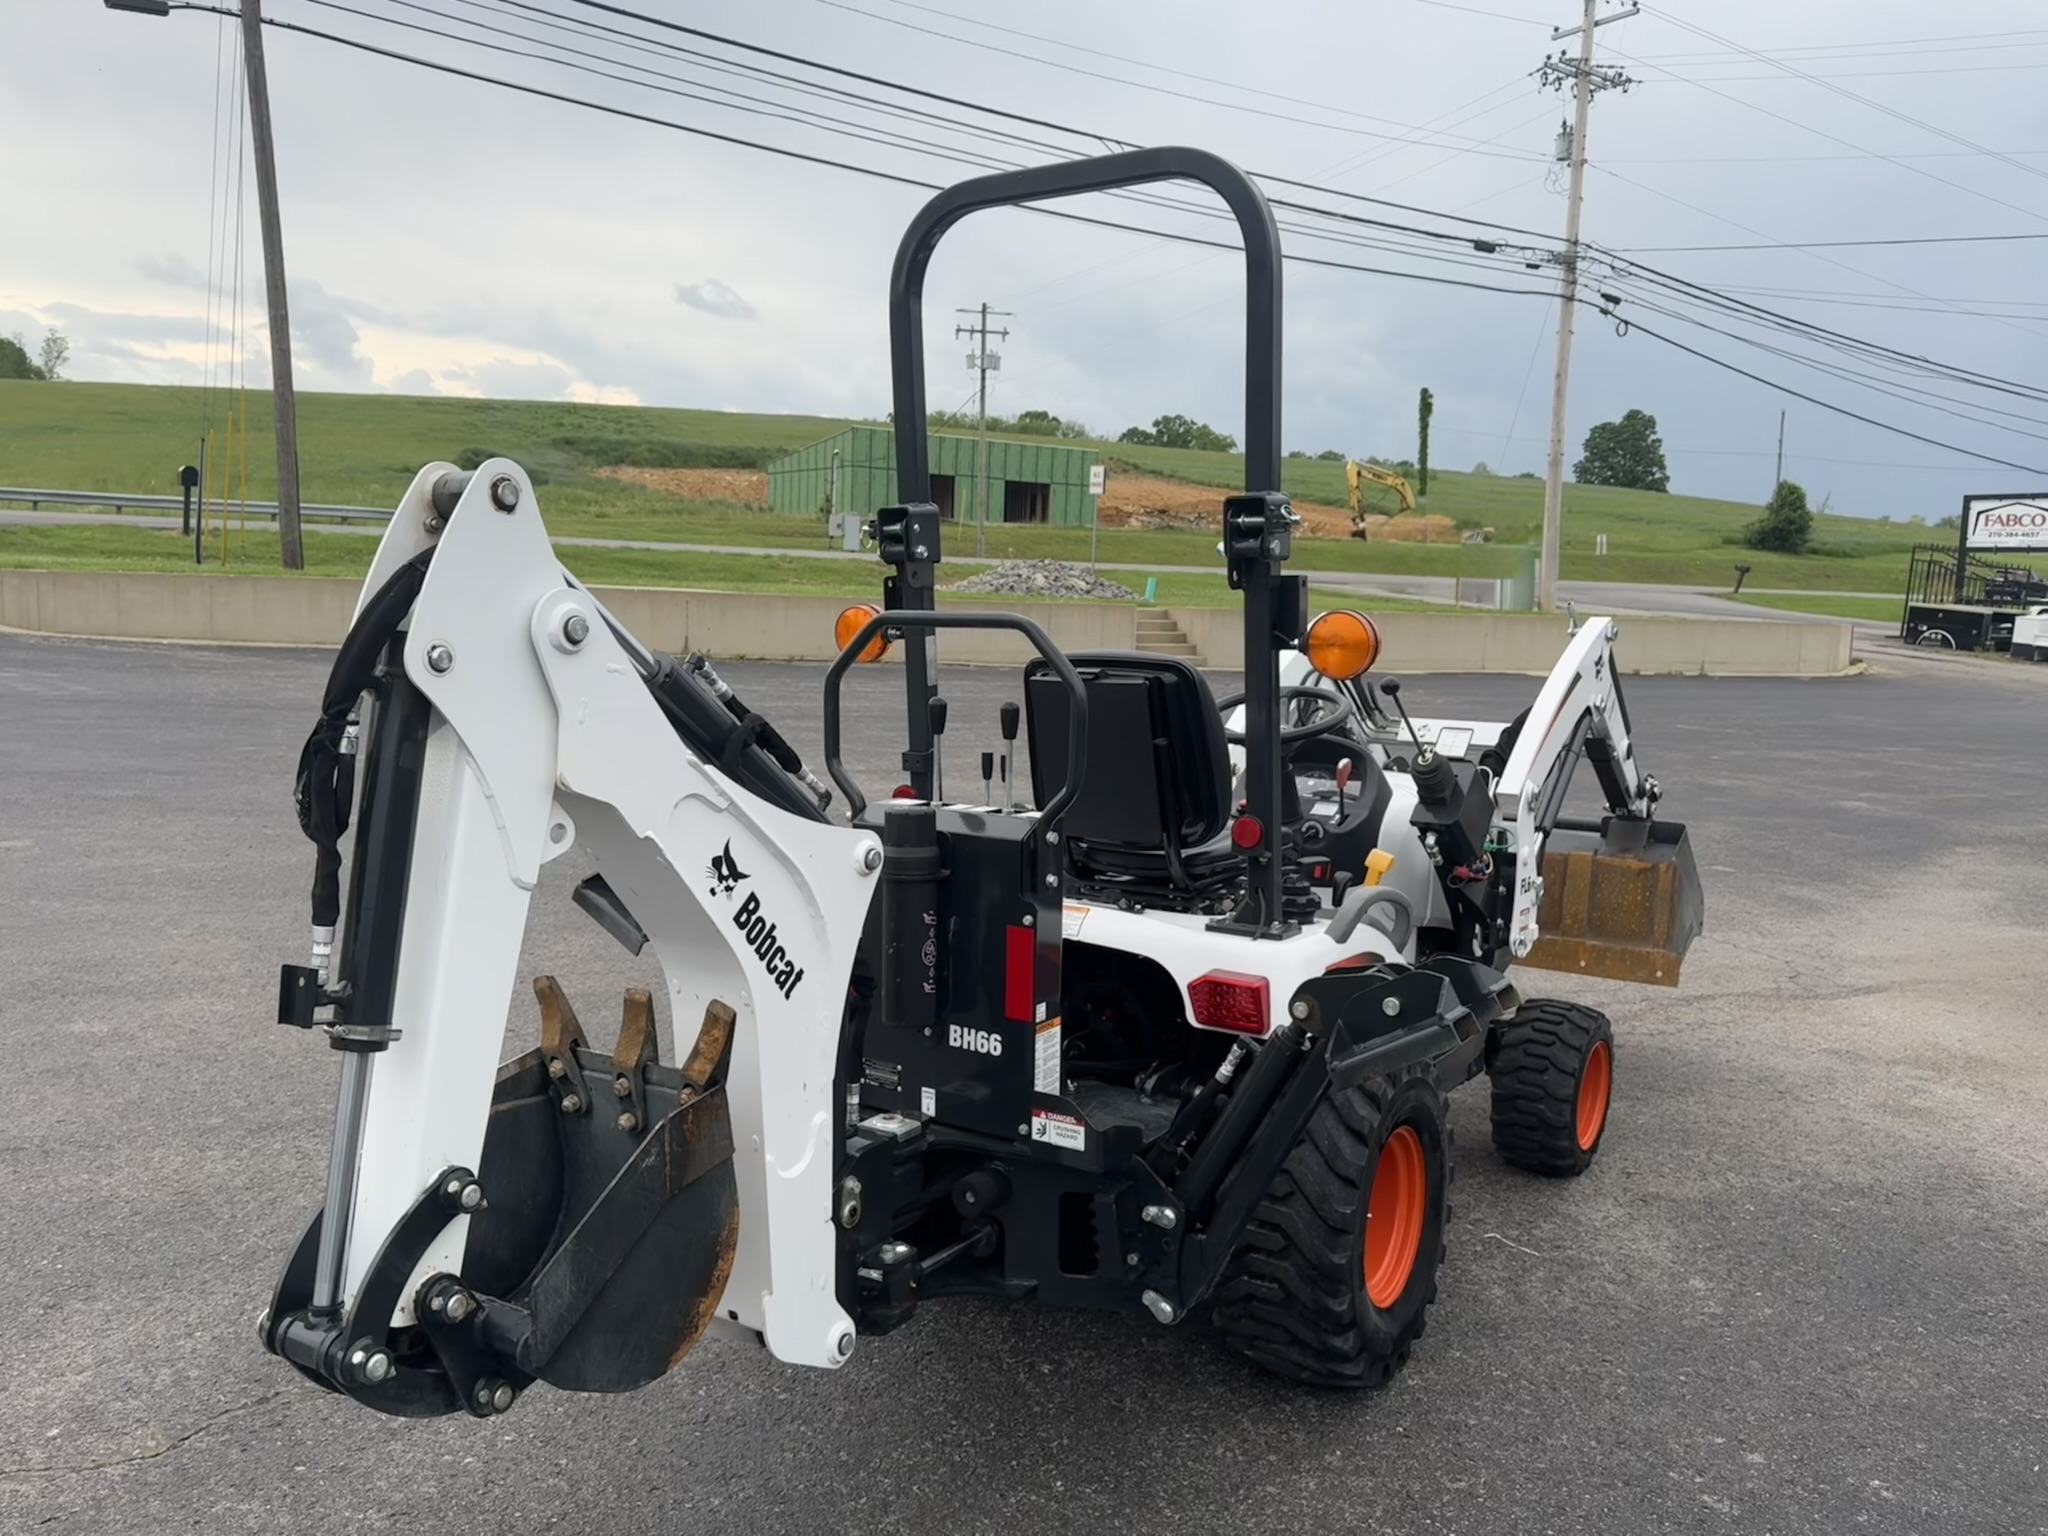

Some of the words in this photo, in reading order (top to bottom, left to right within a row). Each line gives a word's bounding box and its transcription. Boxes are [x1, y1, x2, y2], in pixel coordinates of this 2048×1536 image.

[1984, 513, 2047, 527] FABCO
[733, 891, 804, 1001] Bobcat
[949, 1023, 1003, 1057] BH66
